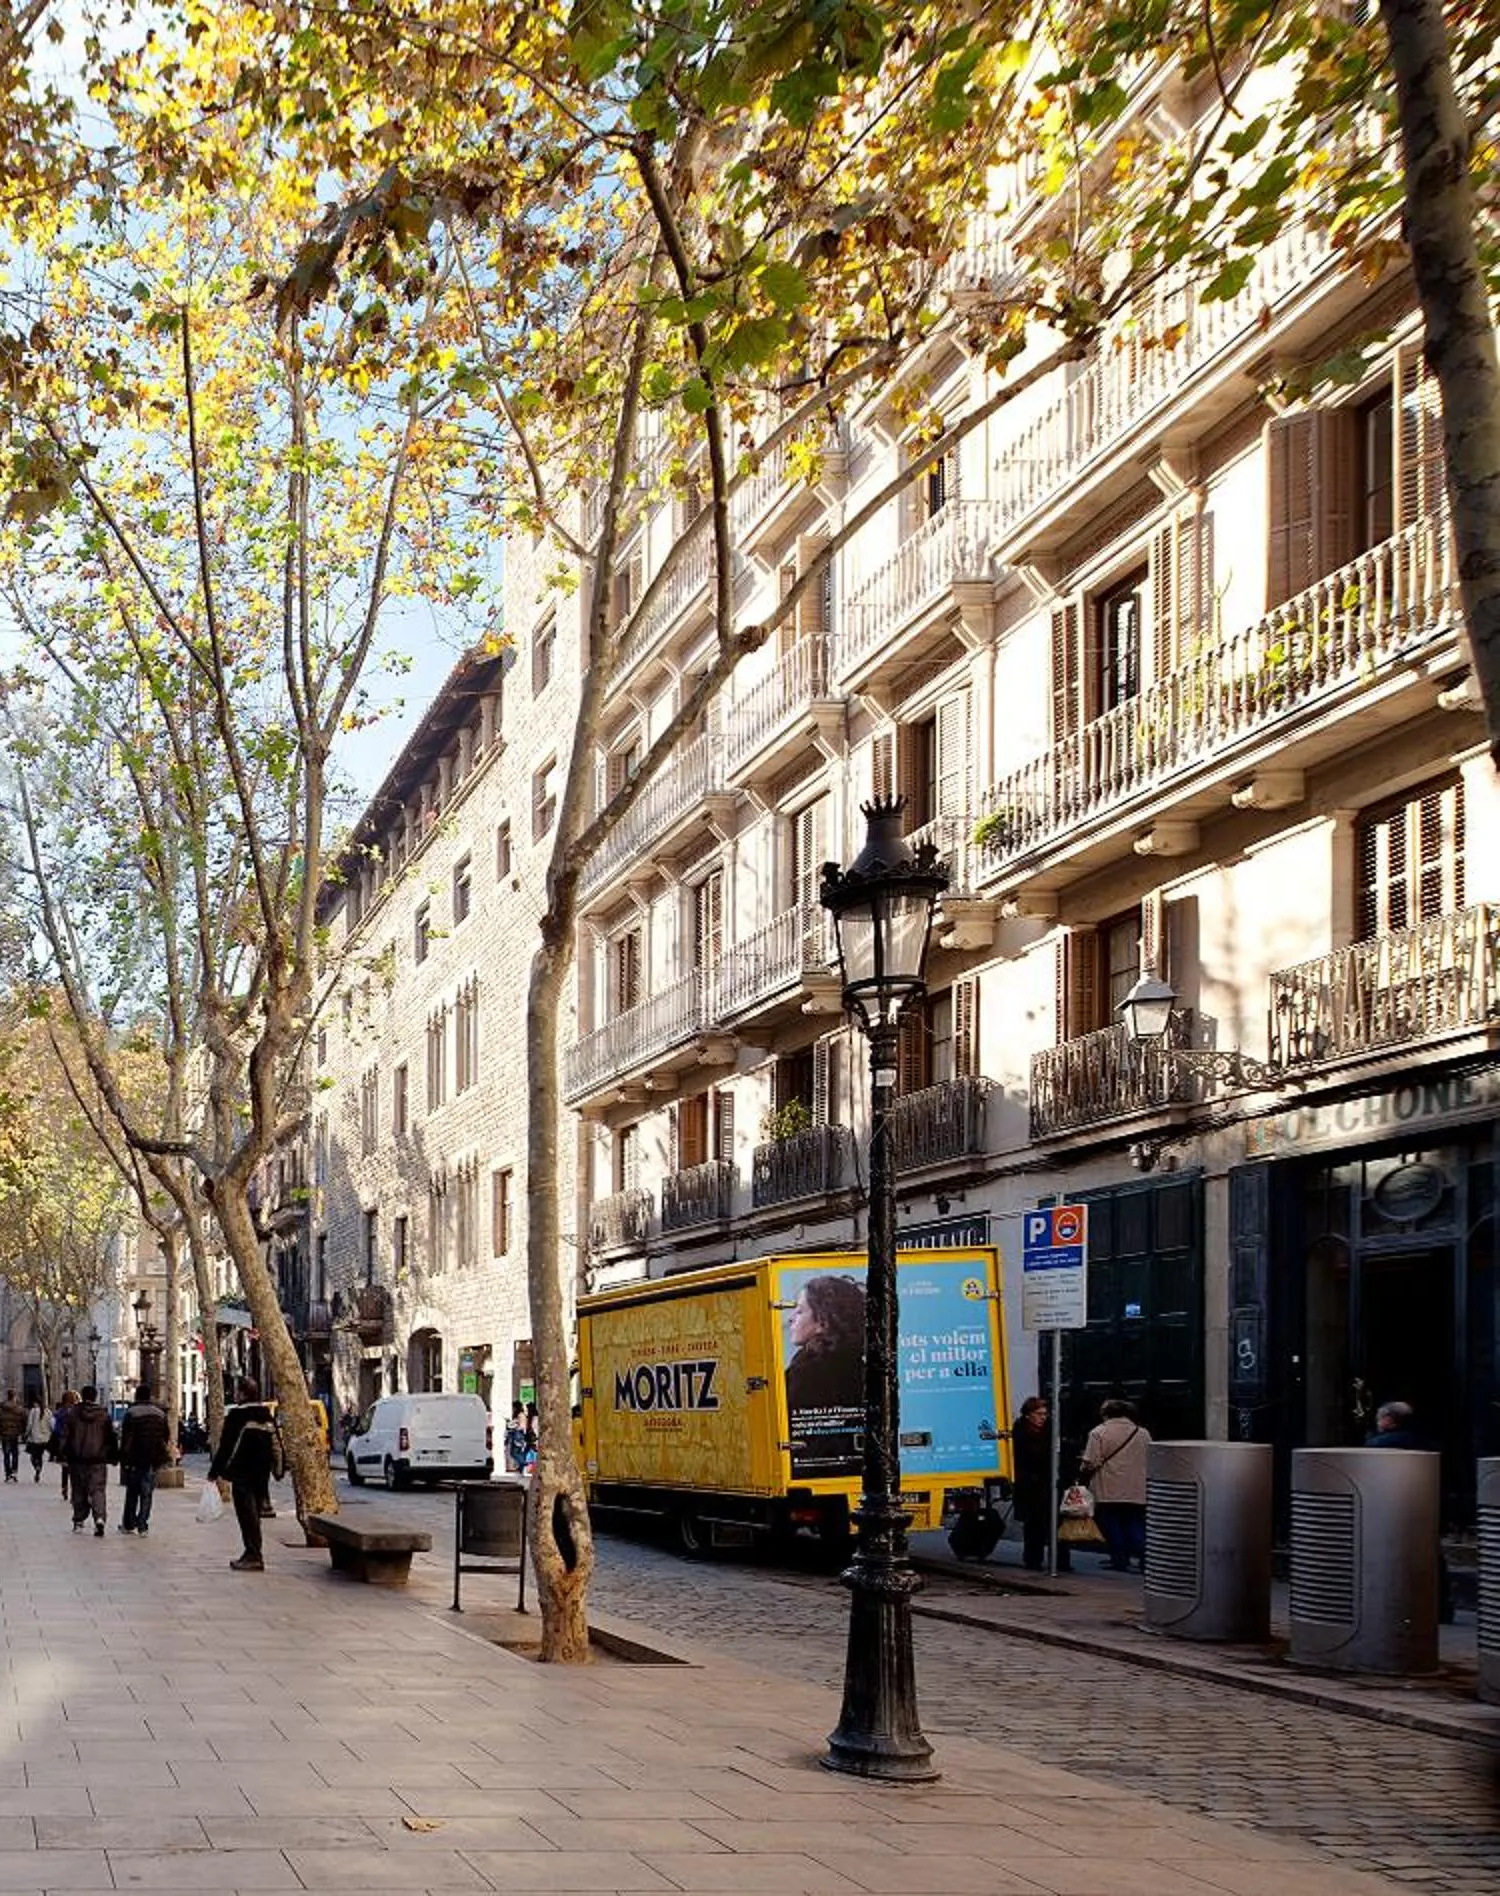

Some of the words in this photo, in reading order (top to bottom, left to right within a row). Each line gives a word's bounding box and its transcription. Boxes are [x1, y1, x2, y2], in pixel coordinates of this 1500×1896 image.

[1029, 1217, 1047, 1244] P
[898, 1331, 928, 1347] ots
[931, 1330, 986, 1345] volem
[909, 1348, 925, 1363] el
[931, 1346, 988, 1362] millor
[904, 1367, 936, 1383] per
[953, 1361, 988, 1377] ella
[614, 1360, 720, 1412] MORITZ
